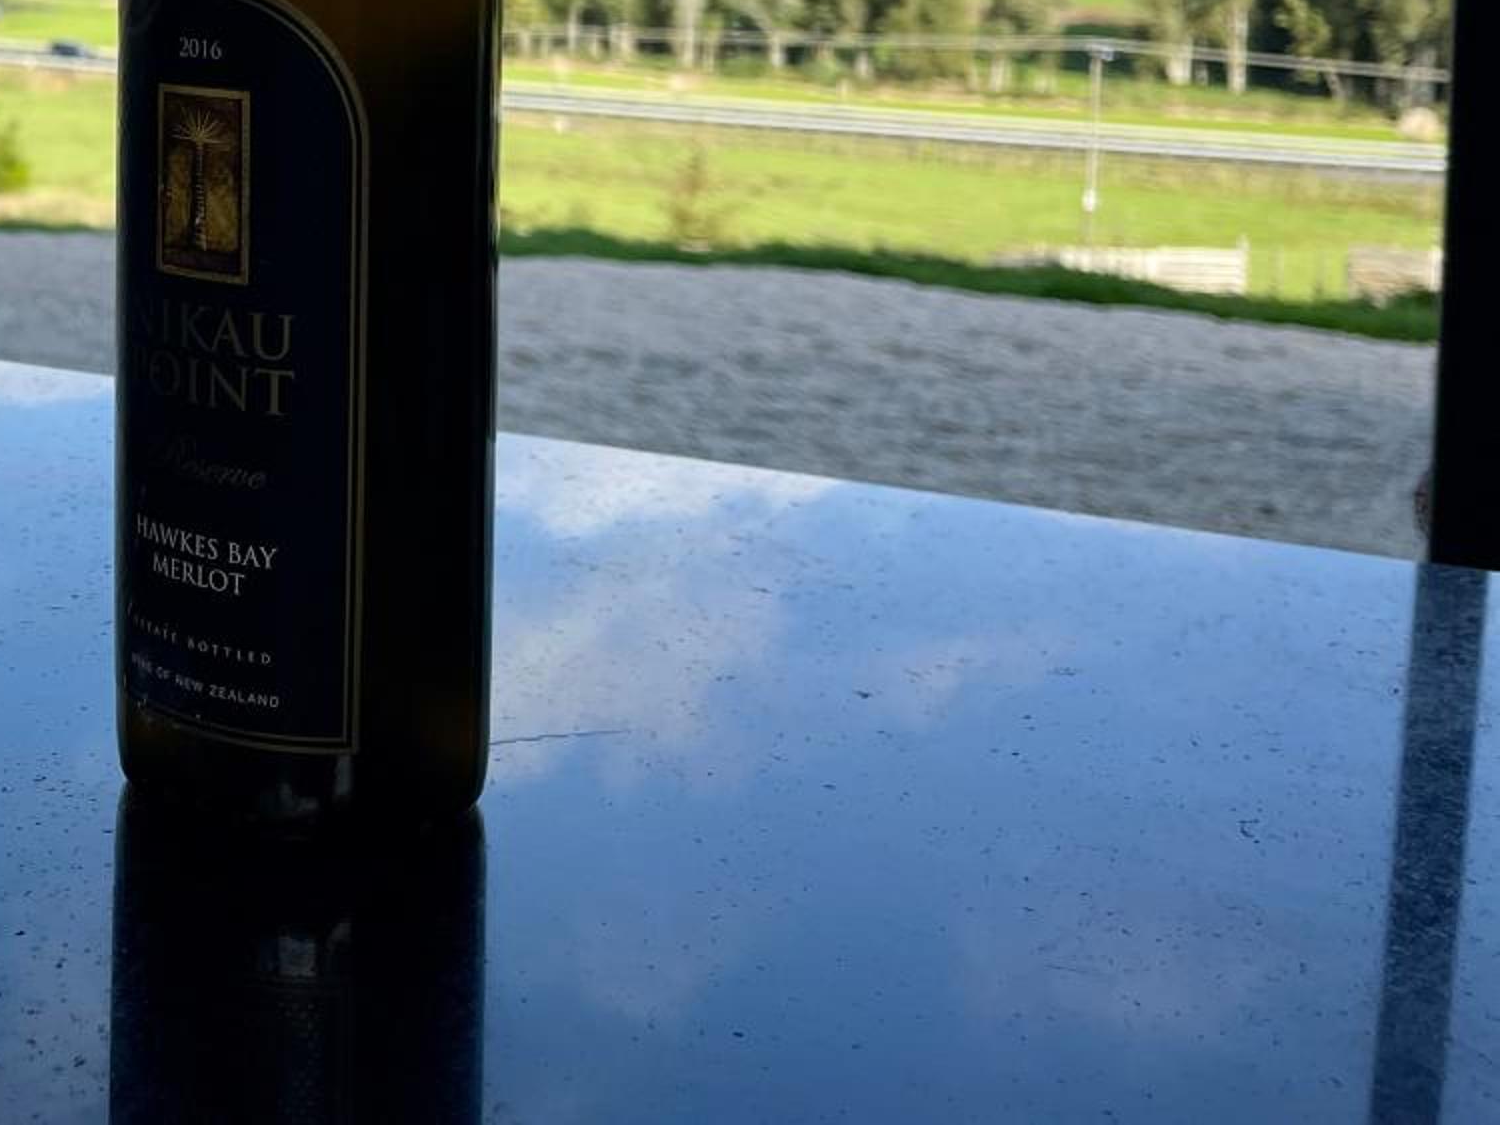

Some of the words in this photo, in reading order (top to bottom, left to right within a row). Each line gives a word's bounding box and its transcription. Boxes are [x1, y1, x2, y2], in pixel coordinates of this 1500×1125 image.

[179, 36, 223, 59] 2016
[132, 345, 296, 416] POINT
[136, 511, 220, 561] HAWKES
[228, 540, 278, 571] BAY
[152, 551, 246, 596] MERLOT
[186, 637, 272, 666] BOTTLED
[176, 673, 204, 697] NEW
[209, 683, 280, 709] ZEALAND
